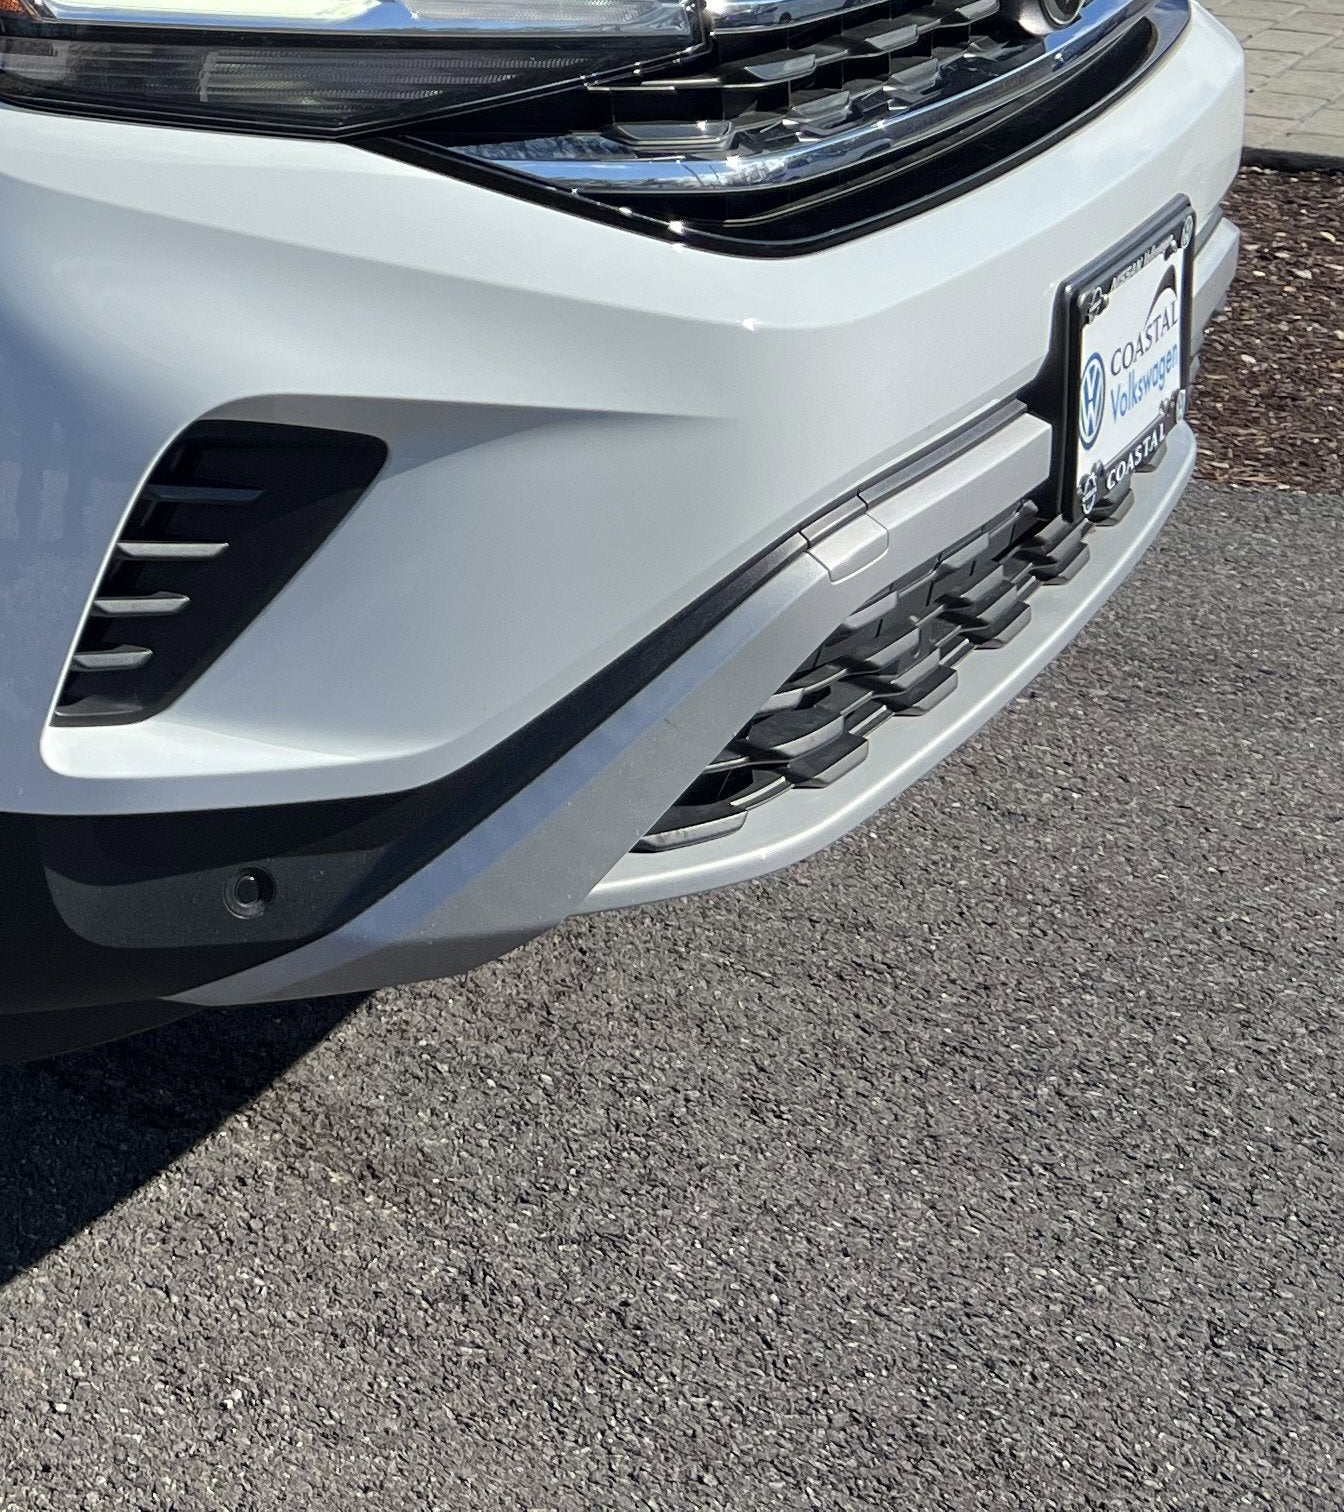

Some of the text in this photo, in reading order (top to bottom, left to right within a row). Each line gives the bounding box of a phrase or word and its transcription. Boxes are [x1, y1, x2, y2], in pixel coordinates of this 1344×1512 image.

[1110, 299, 1179, 377] COASTAL
[1110, 343, 1178, 424] Volkswagen
[1106, 422, 1167, 491] COASTAL
